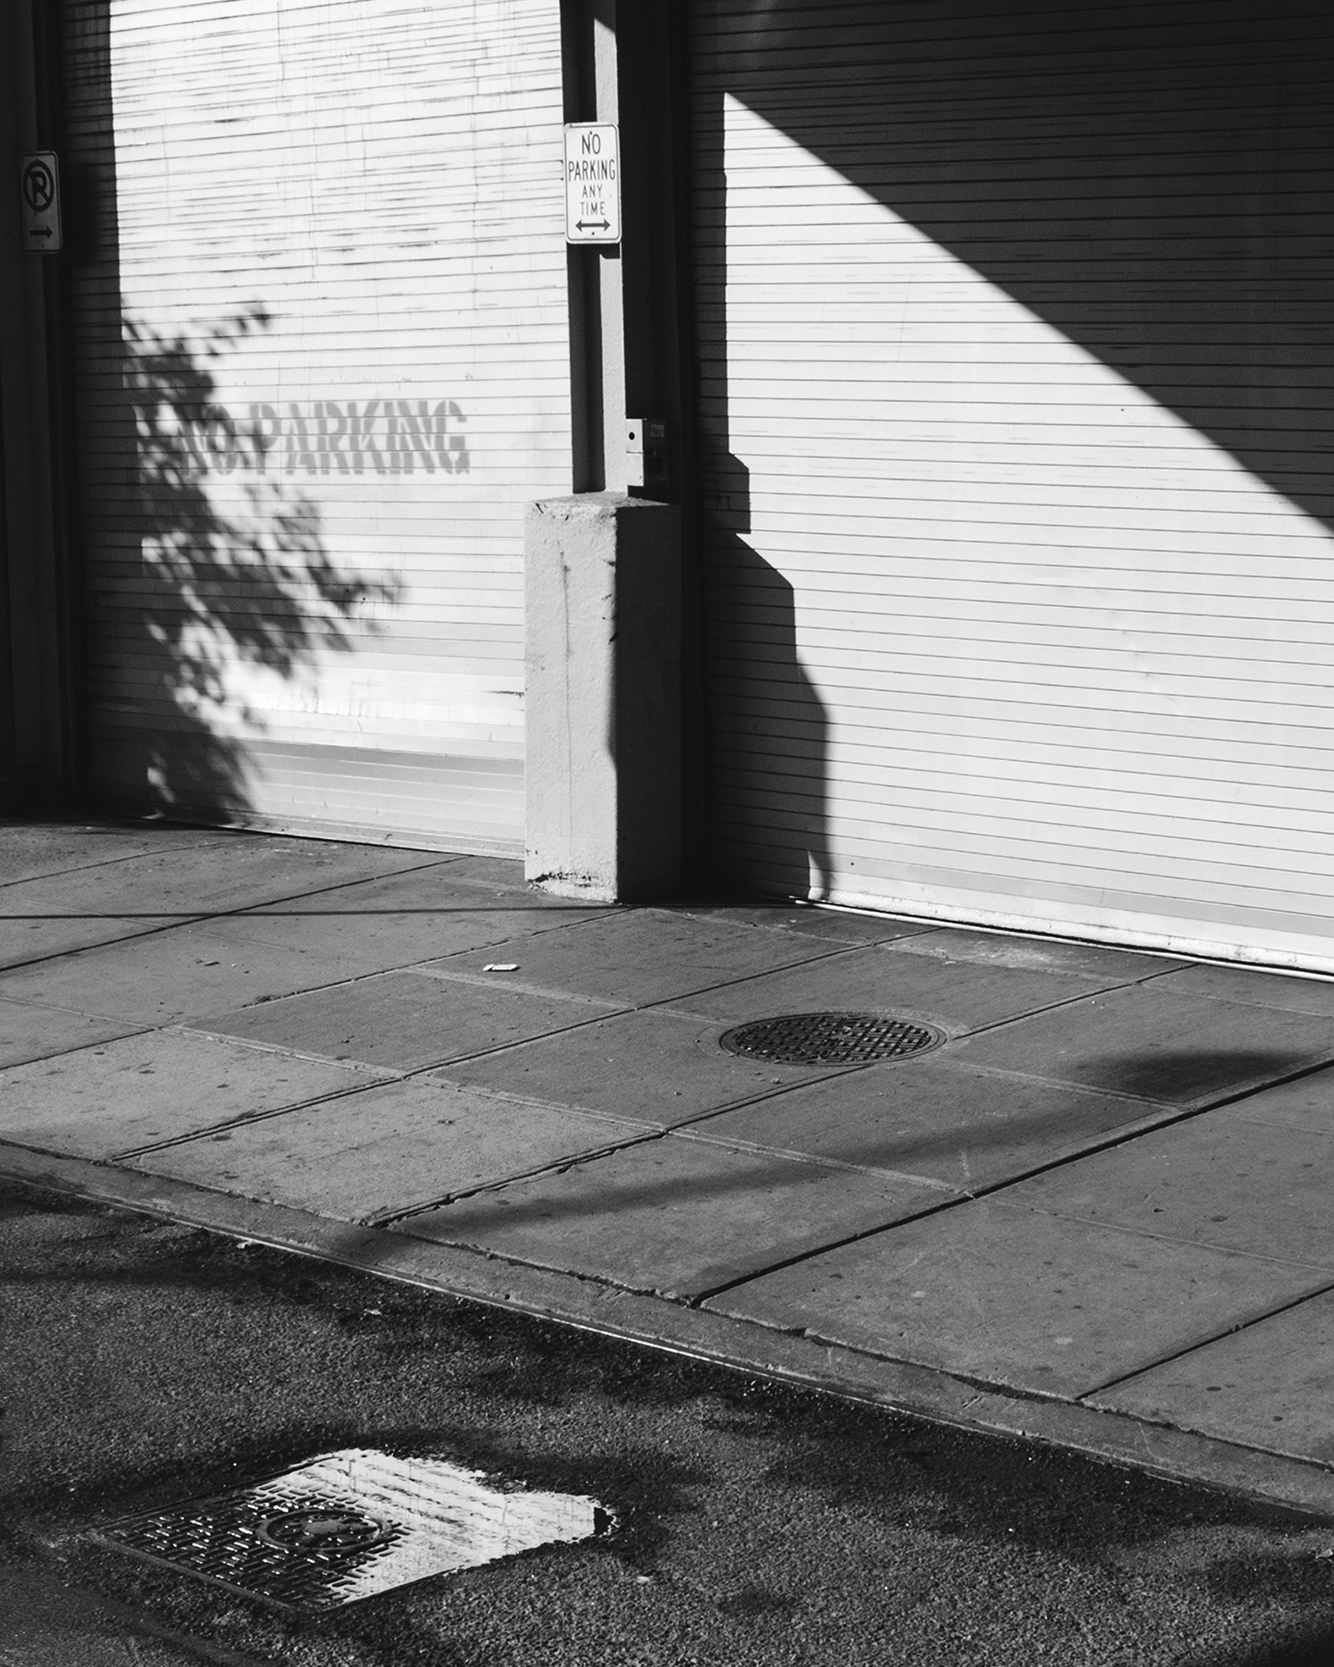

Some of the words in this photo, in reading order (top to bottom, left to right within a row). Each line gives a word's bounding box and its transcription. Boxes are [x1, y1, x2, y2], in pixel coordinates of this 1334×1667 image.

[581, 133, 601, 155] NO
[568, 158, 616, 182] PARKING
[581, 184, 603, 198] ANY
[580, 201, 606, 216] TIME
[179, 404, 240, 477] NO
[249, 399, 472, 477] PARKING
